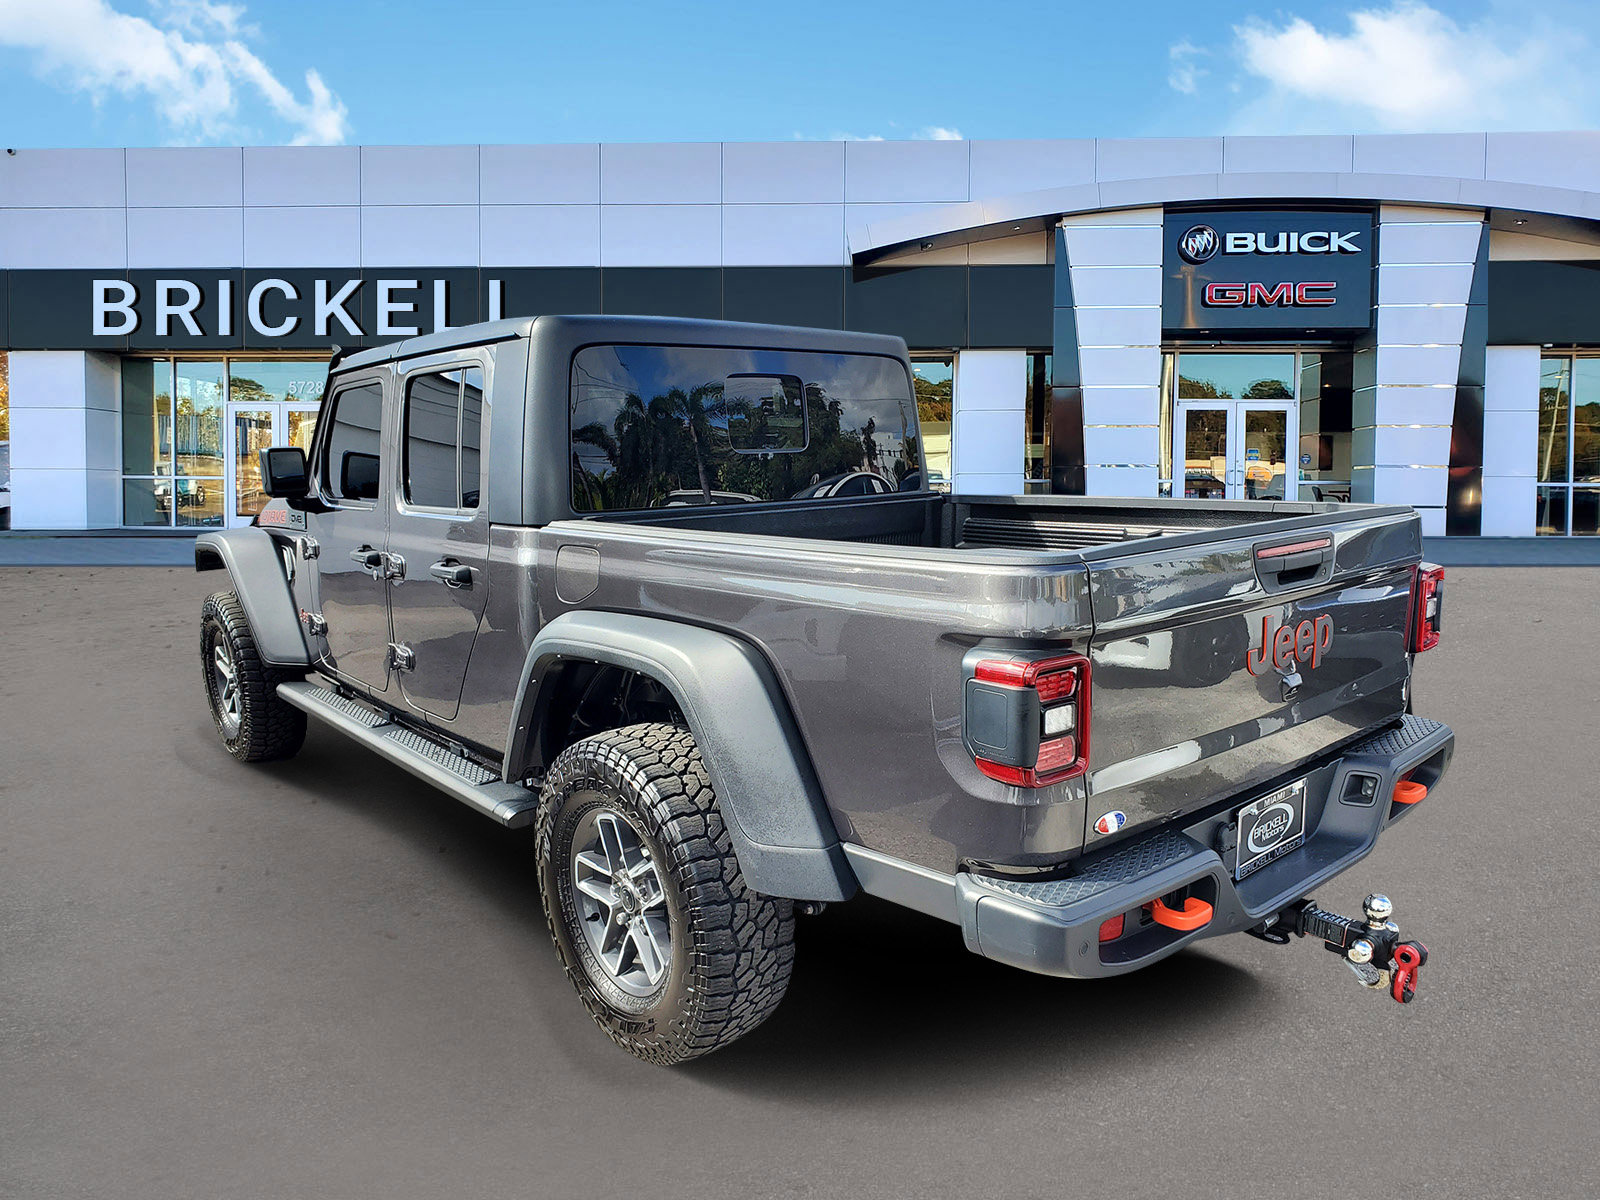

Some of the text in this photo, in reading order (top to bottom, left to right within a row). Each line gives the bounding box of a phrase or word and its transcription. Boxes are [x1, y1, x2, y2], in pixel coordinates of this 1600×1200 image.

[1225, 231, 1362, 253] BUICK
[1205, 281, 1337, 306] GMC
[288, 381, 324, 394] 5728
[1246, 613, 1334, 677] Jeep
[1263, 790, 1286, 808] MIAMI
[1253, 813, 1288, 840] BRICKELL
[1239, 851, 1273, 876] BRICKELL
